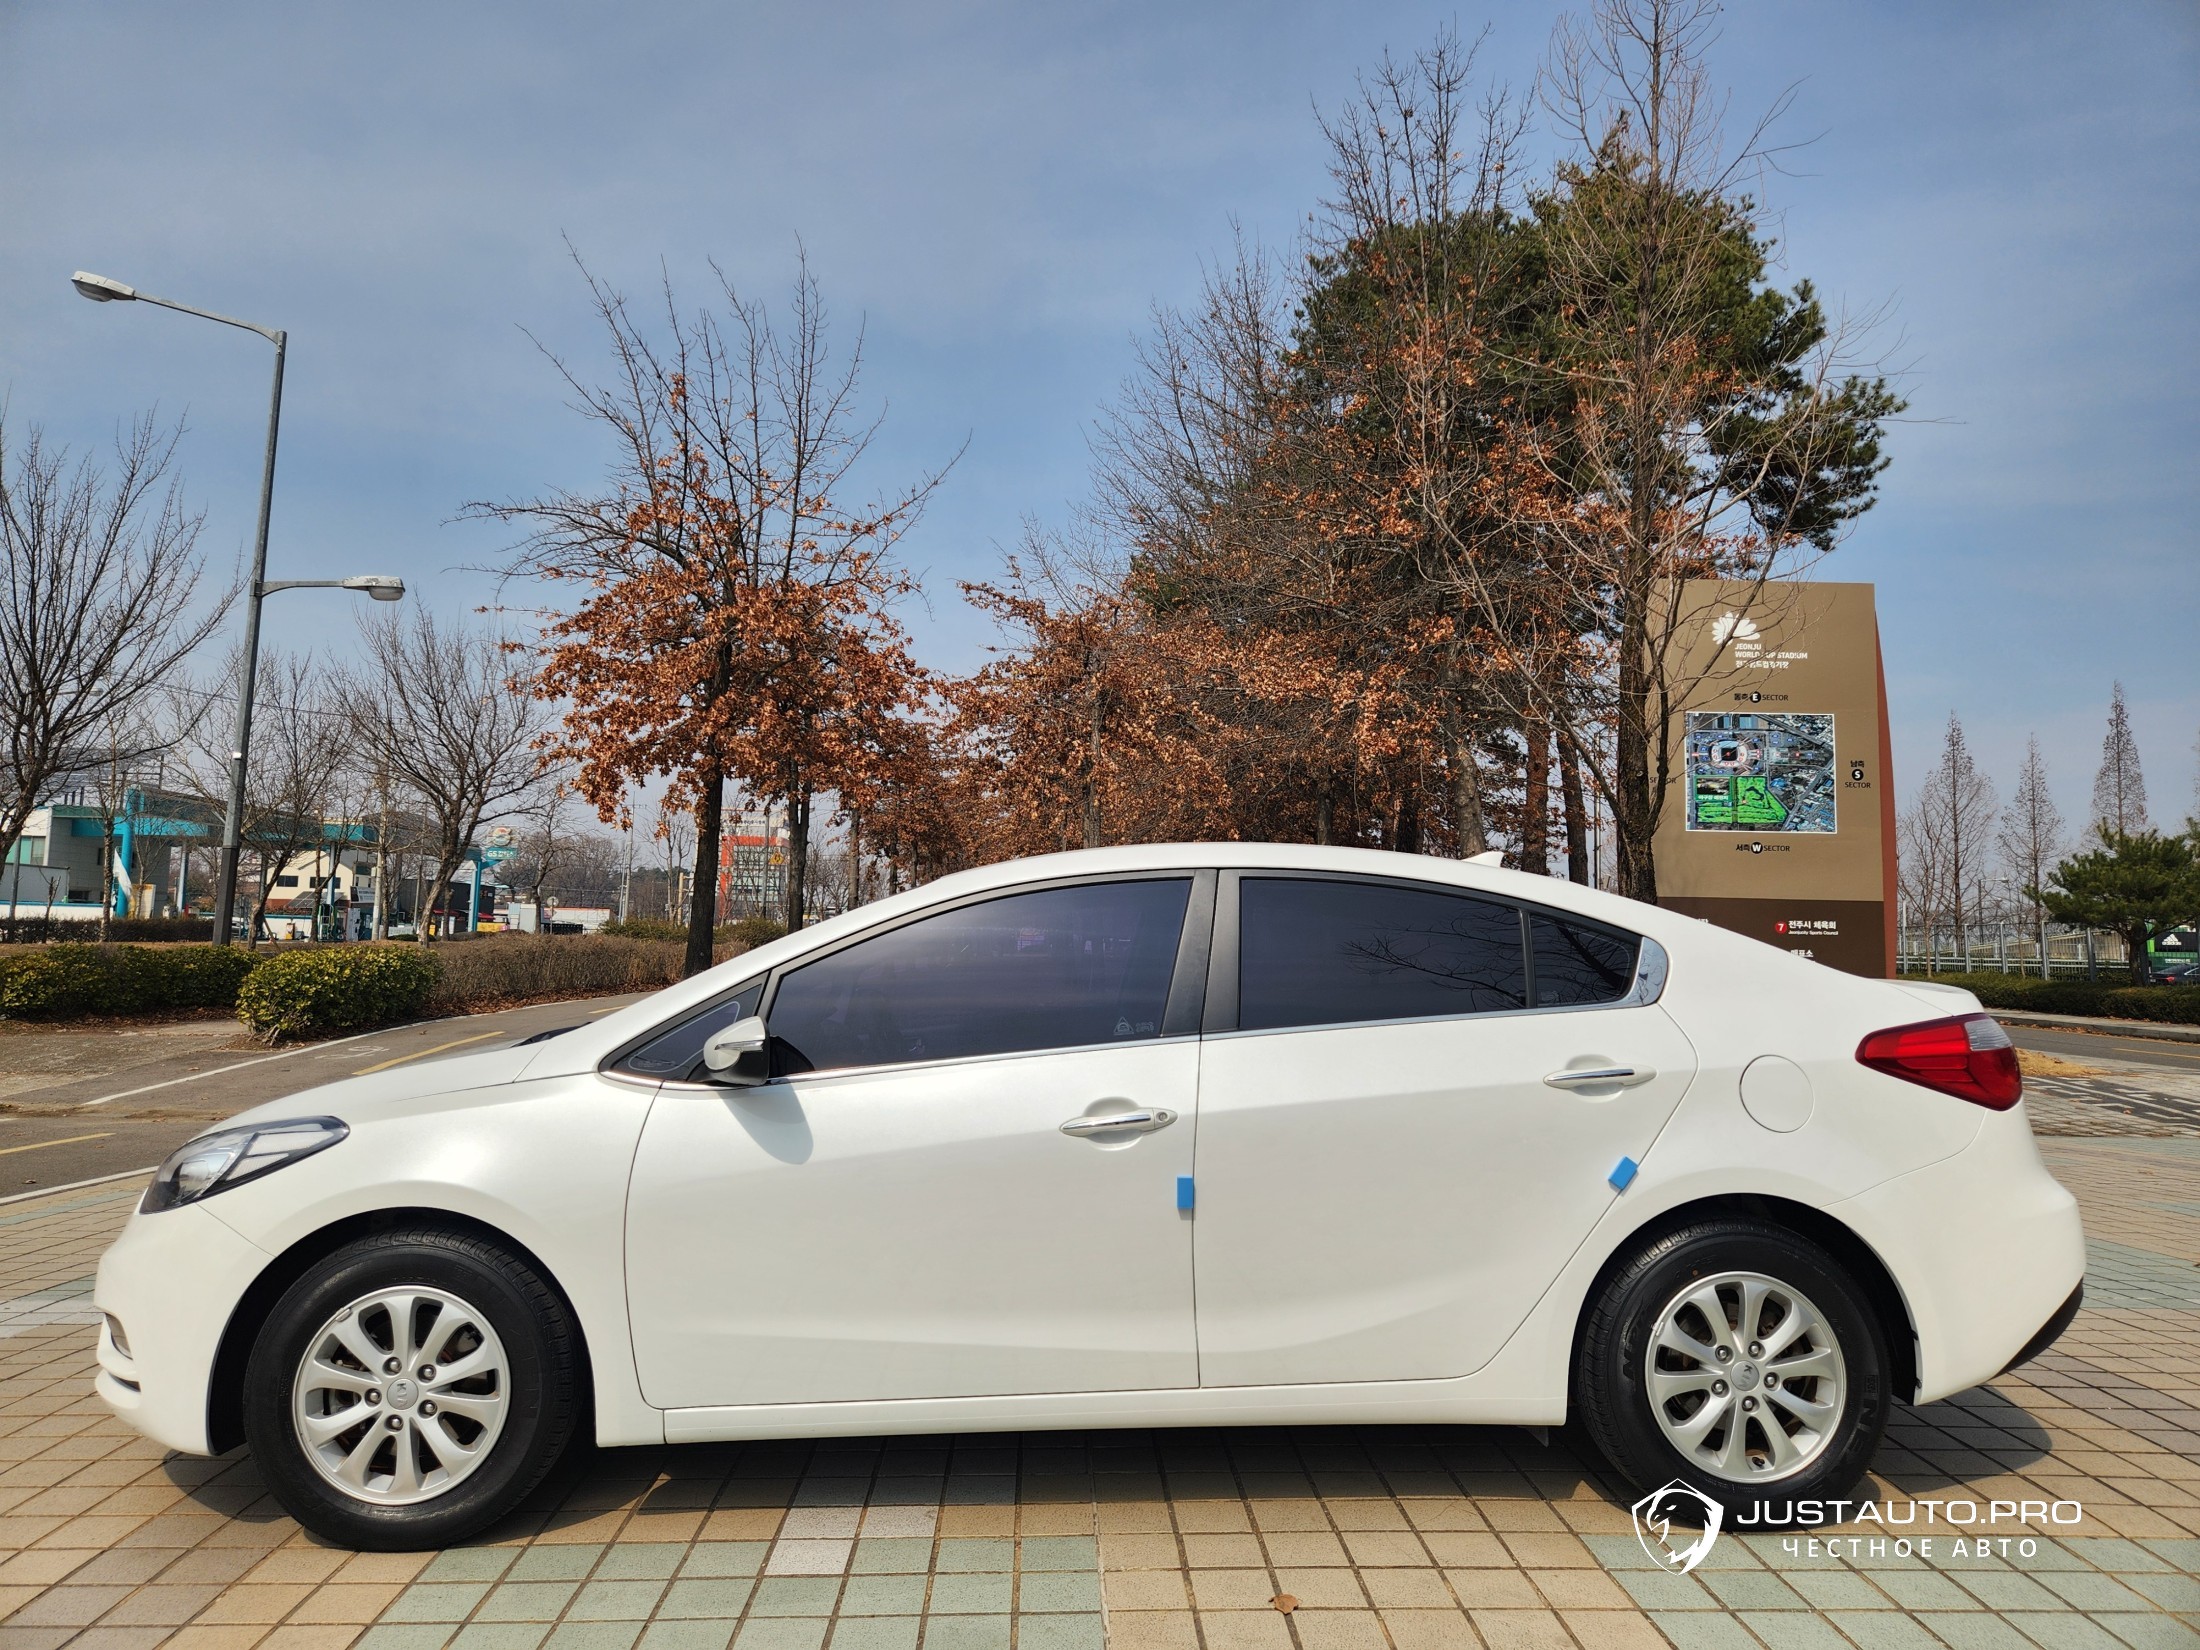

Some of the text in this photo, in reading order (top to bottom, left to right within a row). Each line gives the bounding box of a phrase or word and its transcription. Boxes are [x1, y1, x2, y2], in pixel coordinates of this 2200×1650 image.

[1777, 651, 1808, 659] STADIUM
[1762, 694, 1789, 702] SECTOR
[1649, 776, 1677, 784] SEOR
[1844, 781, 1872, 789] SECTOR
[1788, 920, 1811, 930] 전주시
